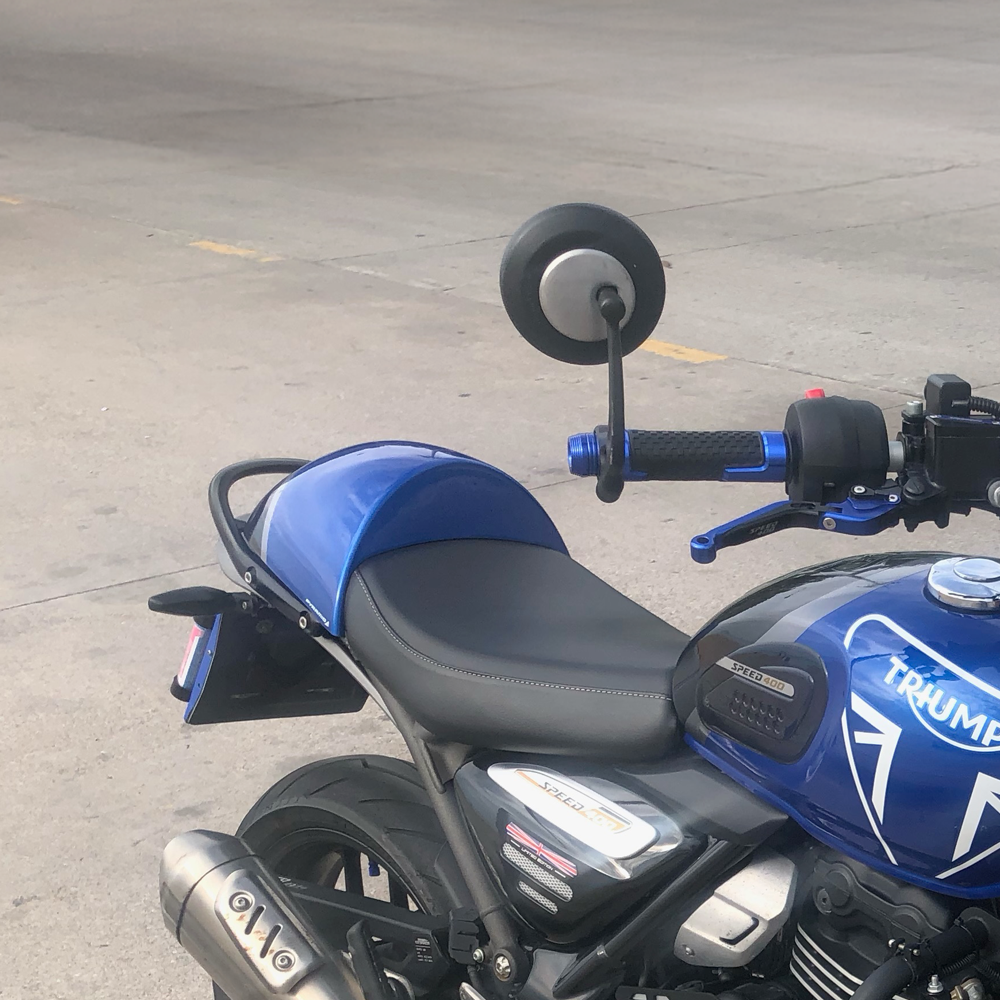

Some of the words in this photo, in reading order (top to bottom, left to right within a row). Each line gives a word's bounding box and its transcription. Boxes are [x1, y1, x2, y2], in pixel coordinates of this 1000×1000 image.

[730, 662, 763, 682] SPEED
[763, 676, 786, 691] 400
[539, 781, 585, 812] SPEED
